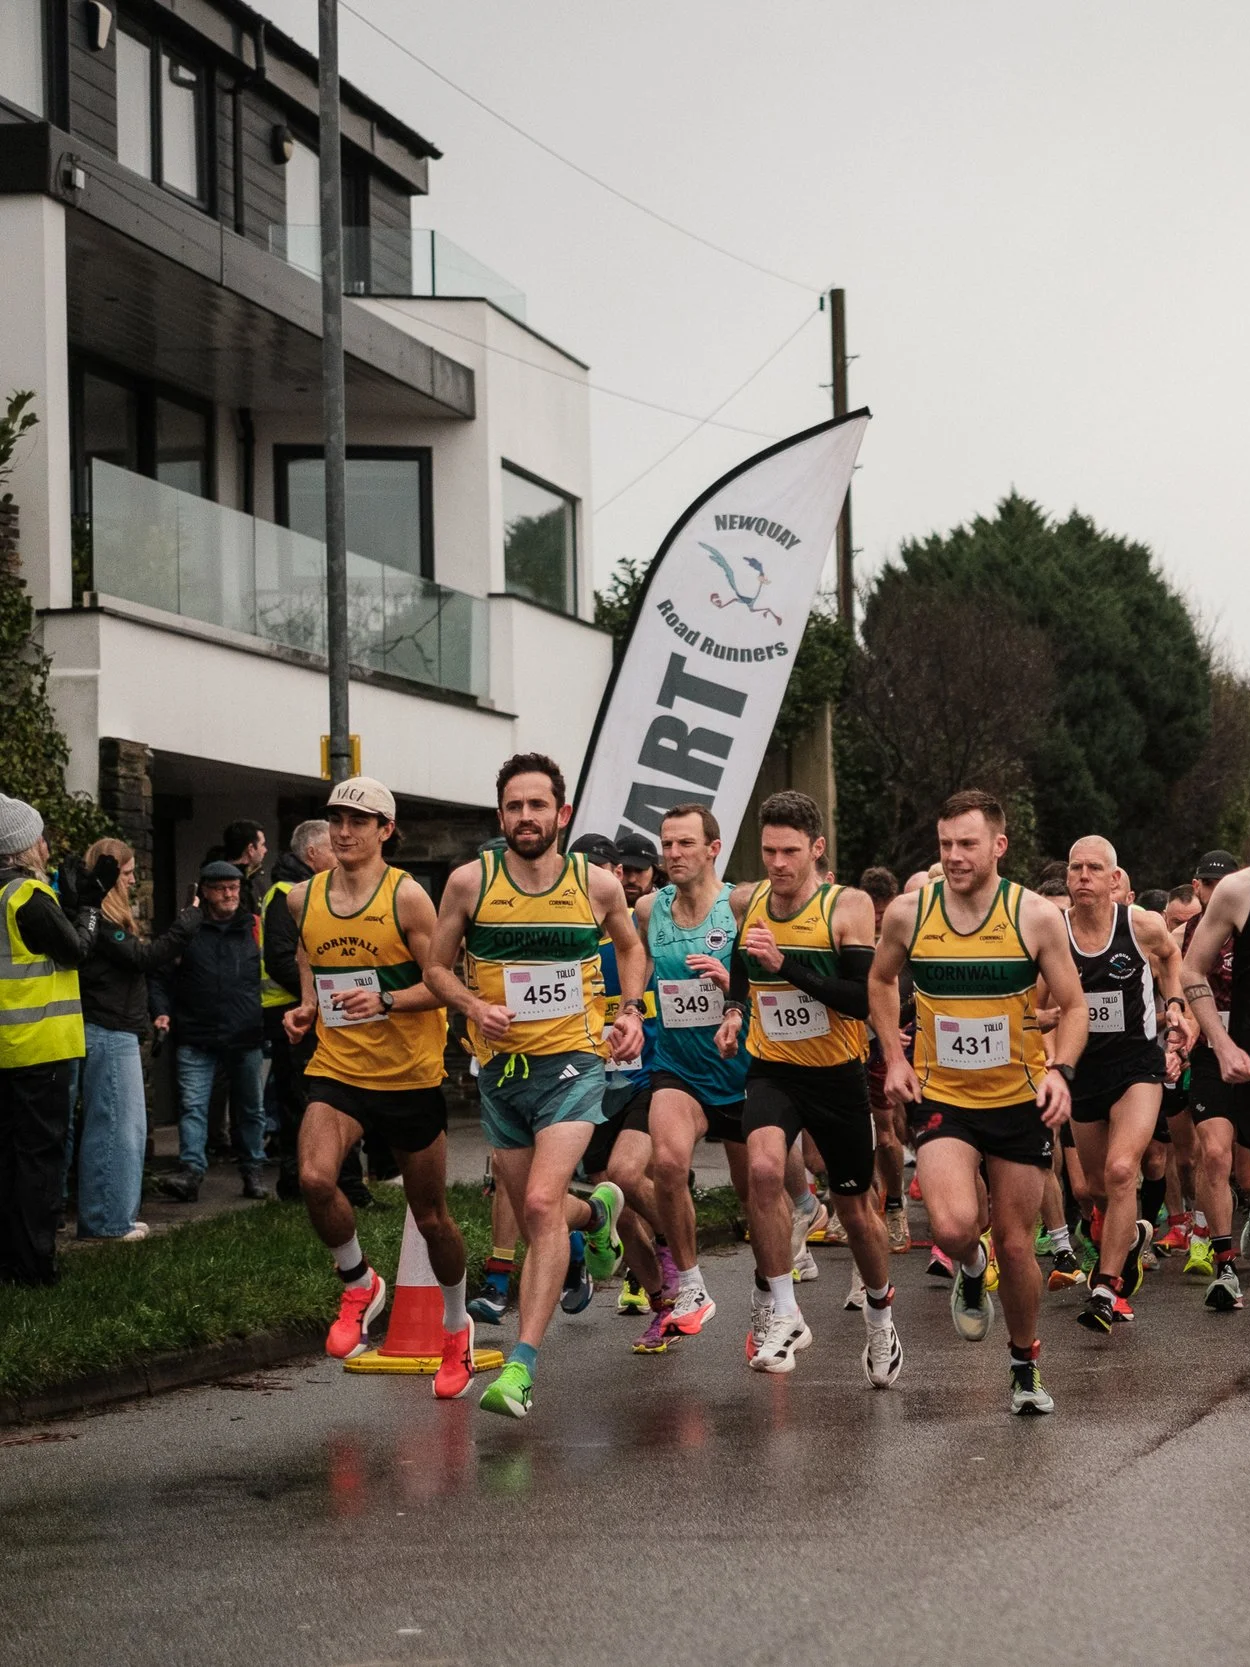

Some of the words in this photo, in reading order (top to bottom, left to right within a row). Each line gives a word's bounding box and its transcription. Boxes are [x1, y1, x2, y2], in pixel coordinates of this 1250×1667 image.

[714, 514, 801, 550] NEWQUAY
[656, 599, 701, 646] Road
[700, 637, 789, 663] Runners
[614, 652, 748, 842] ART
[317, 936, 379, 956] CORNWALL
[496, 931, 578, 947] CORNWALL
[341, 948, 356, 956] AC
[926, 965, 1009, 981] CORNWALL
[524, 983, 567, 1005] 455
[673, 995, 709, 1014] 349
[1089, 1007, 1110, 1021] 98
[774, 1007, 810, 1027] 189
[952, 1036, 991, 1055] 431
